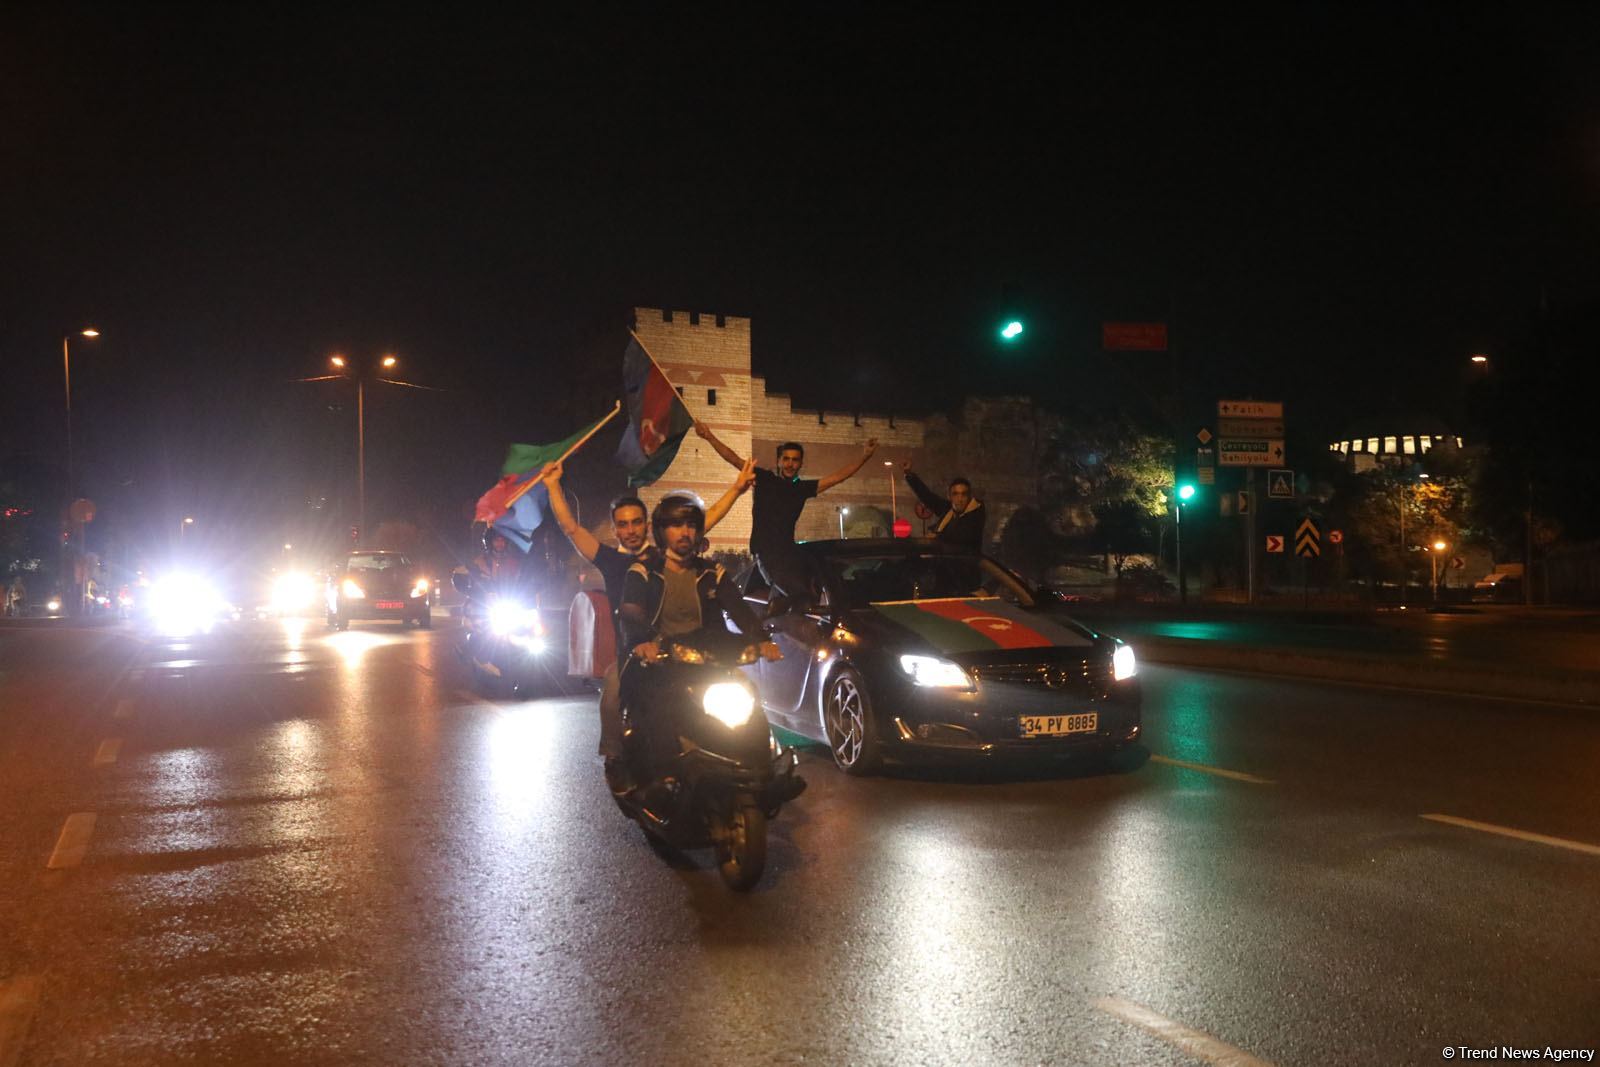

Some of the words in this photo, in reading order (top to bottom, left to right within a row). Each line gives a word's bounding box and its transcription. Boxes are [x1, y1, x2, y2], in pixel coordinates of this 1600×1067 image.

[1232, 404, 1264, 414] Fatih
[1026, 718, 1042, 732] 34
[1047, 716, 1063, 732] PV
[1067, 714, 1096, 731] 8885
